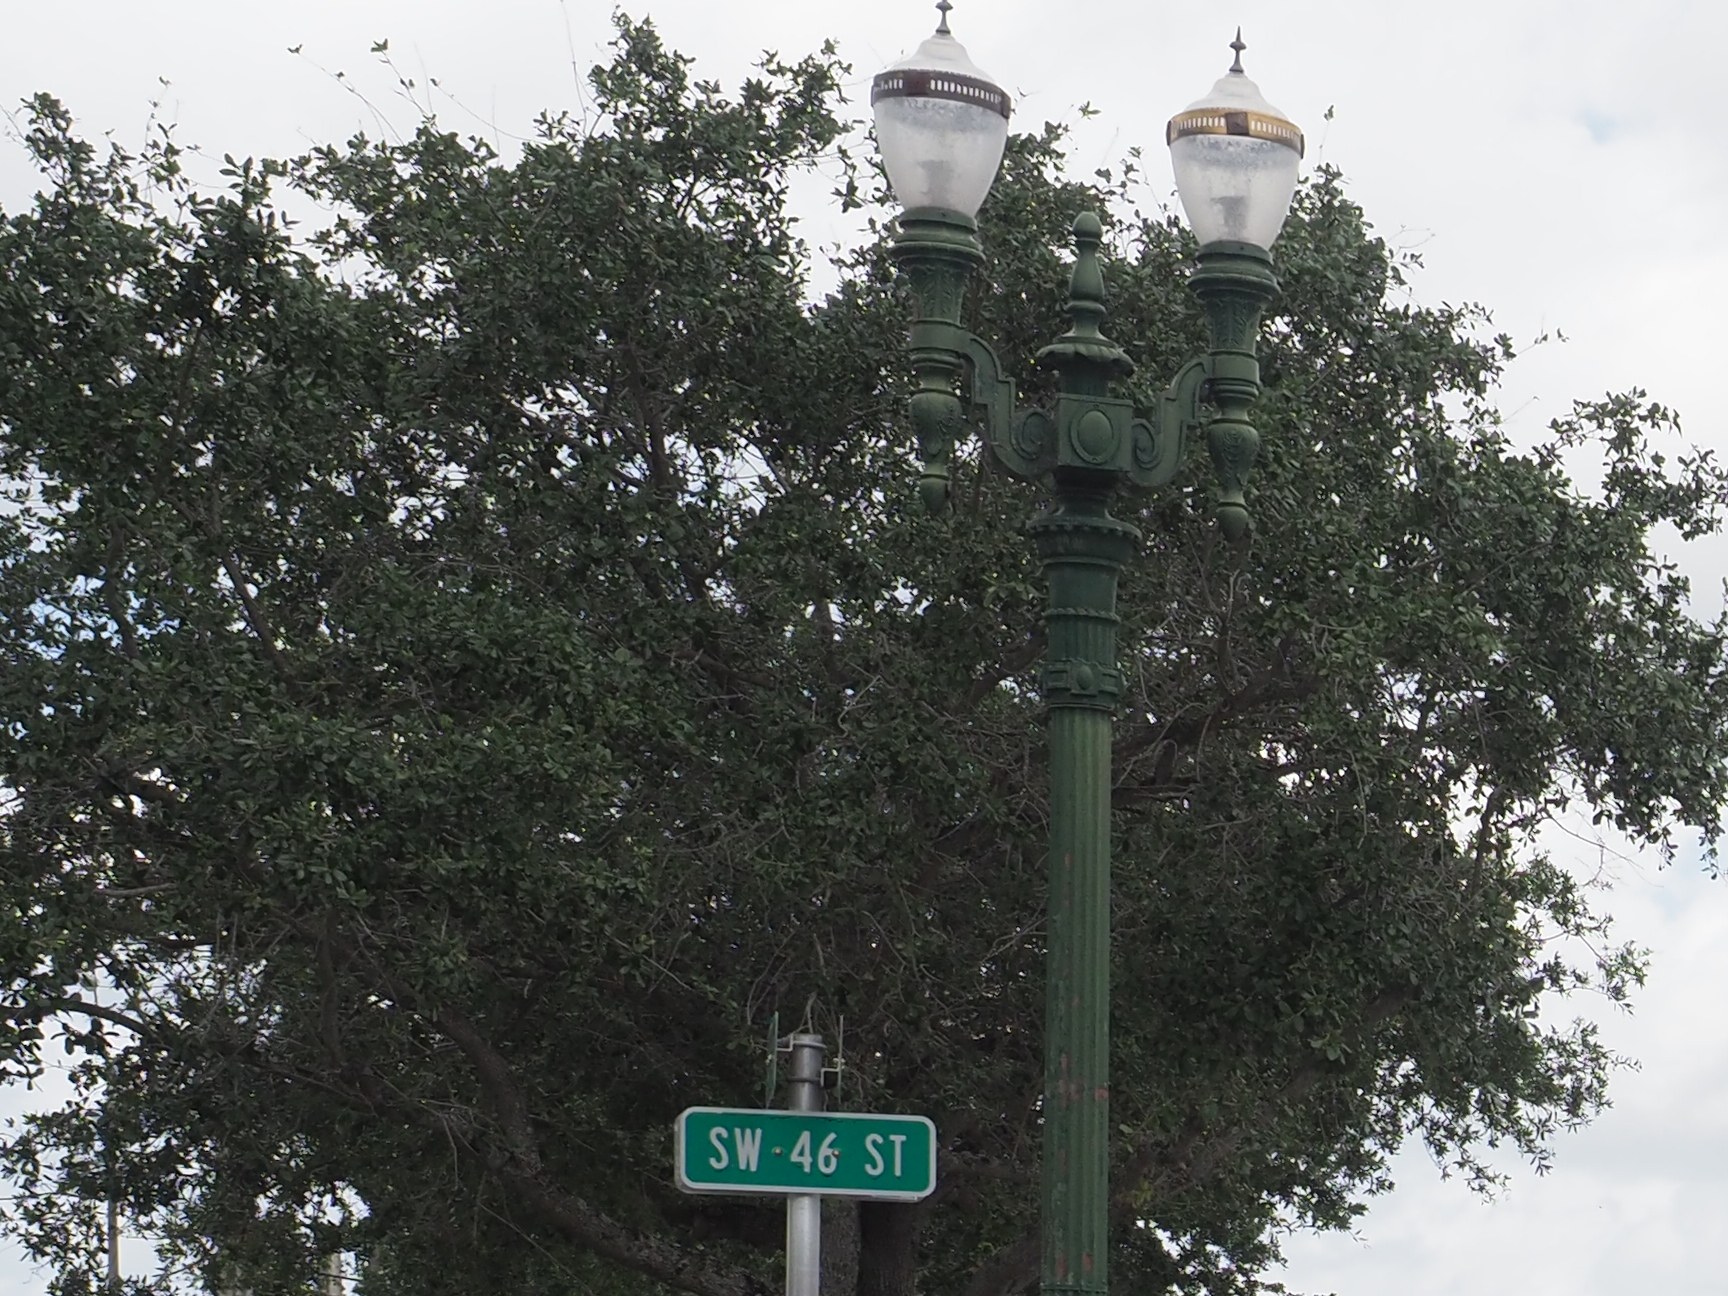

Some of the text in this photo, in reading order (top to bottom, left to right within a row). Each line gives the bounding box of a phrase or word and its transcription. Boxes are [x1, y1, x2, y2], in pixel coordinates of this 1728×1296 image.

[708, 1126, 907, 1177] SW 46 ST
